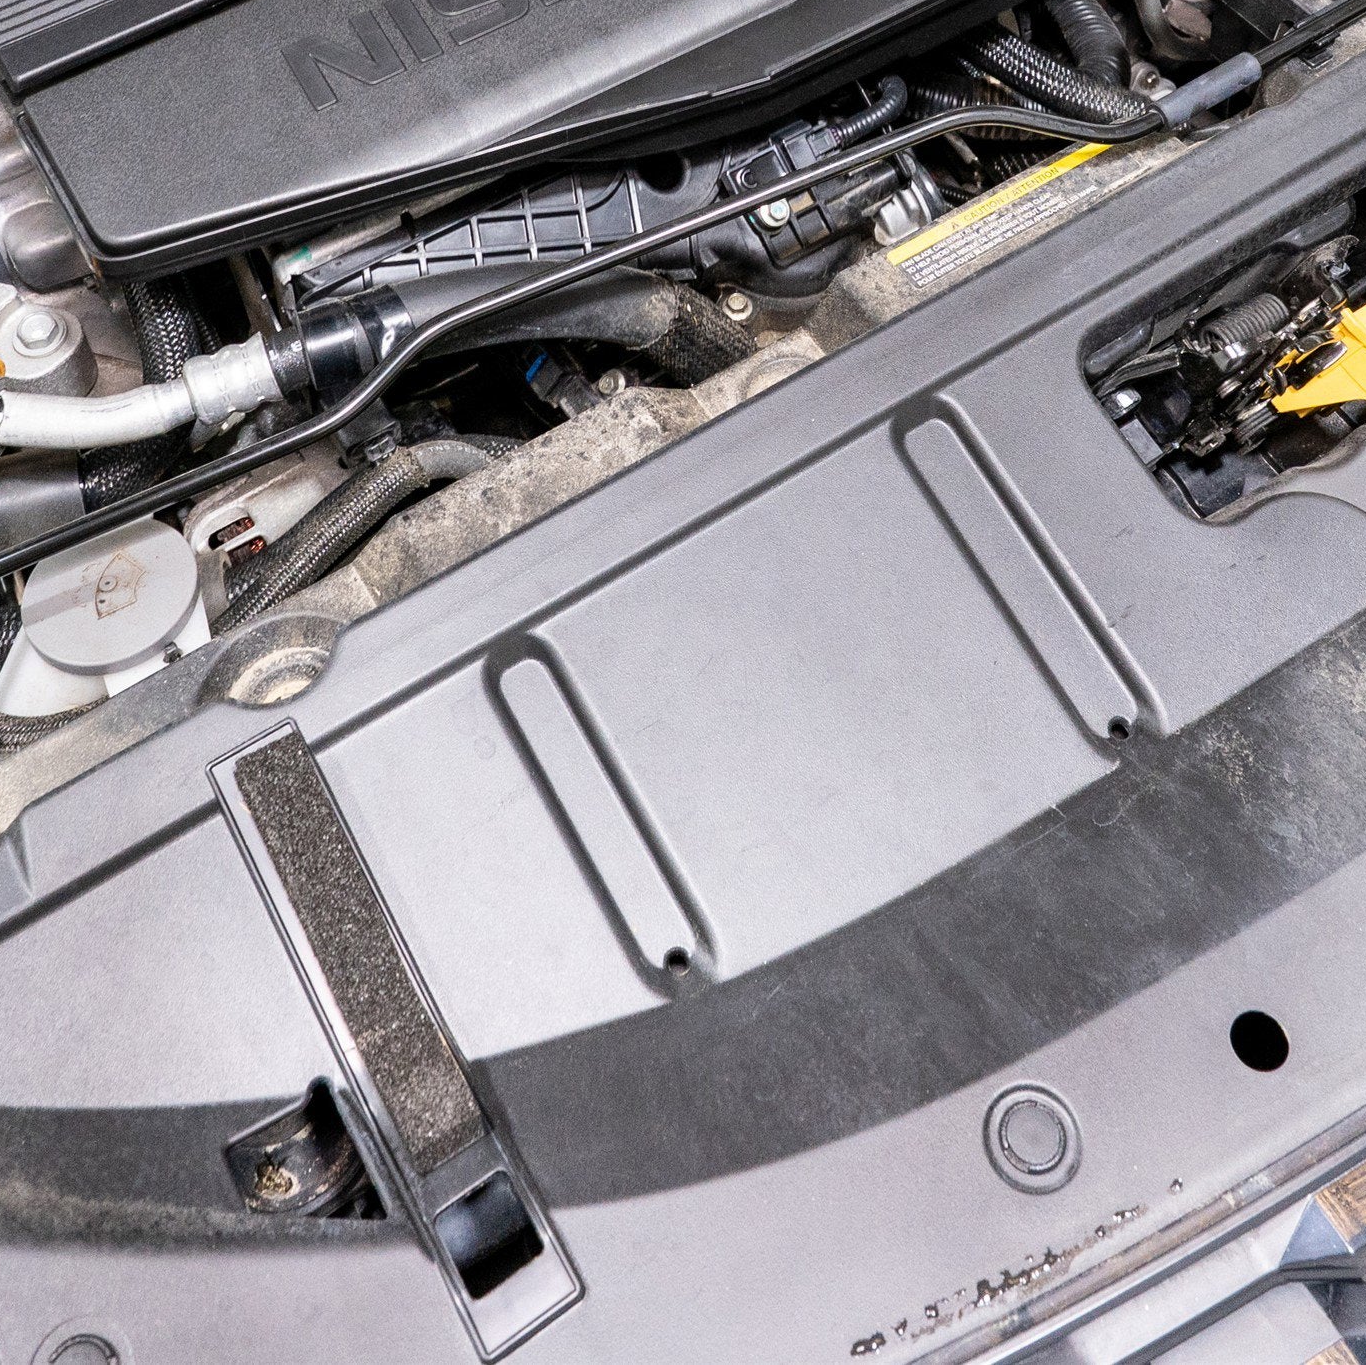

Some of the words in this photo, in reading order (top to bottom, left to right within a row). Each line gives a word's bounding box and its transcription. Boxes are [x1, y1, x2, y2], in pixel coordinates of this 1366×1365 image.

[963, 196, 1004, 222] CAUTION
[1012, 168, 1058, 196] ATTENTION
[901, 258, 914, 268] FAN
[913, 248, 933, 262] BLADE
[932, 241, 946, 251] CAN
[906, 266, 916, 274] TO
[915, 258, 932, 269] HELP
[931, 248, 950, 261] AVOID
[912, 272, 921, 281] LE
[920, 253, 958, 275] VENTILATEUR
[979, 236, 988, 244] DE
[917, 273, 935, 286] POUR
[934, 262, 955, 277] ÉVITER
[954, 252, 974, 266] TOUTE
[1004, 230, 1014, 239] NE
[1013, 224, 1026, 234] PAS
[1034, 201, 1068, 221] APPROCHER
[1066, 194, 1079, 204] LES
